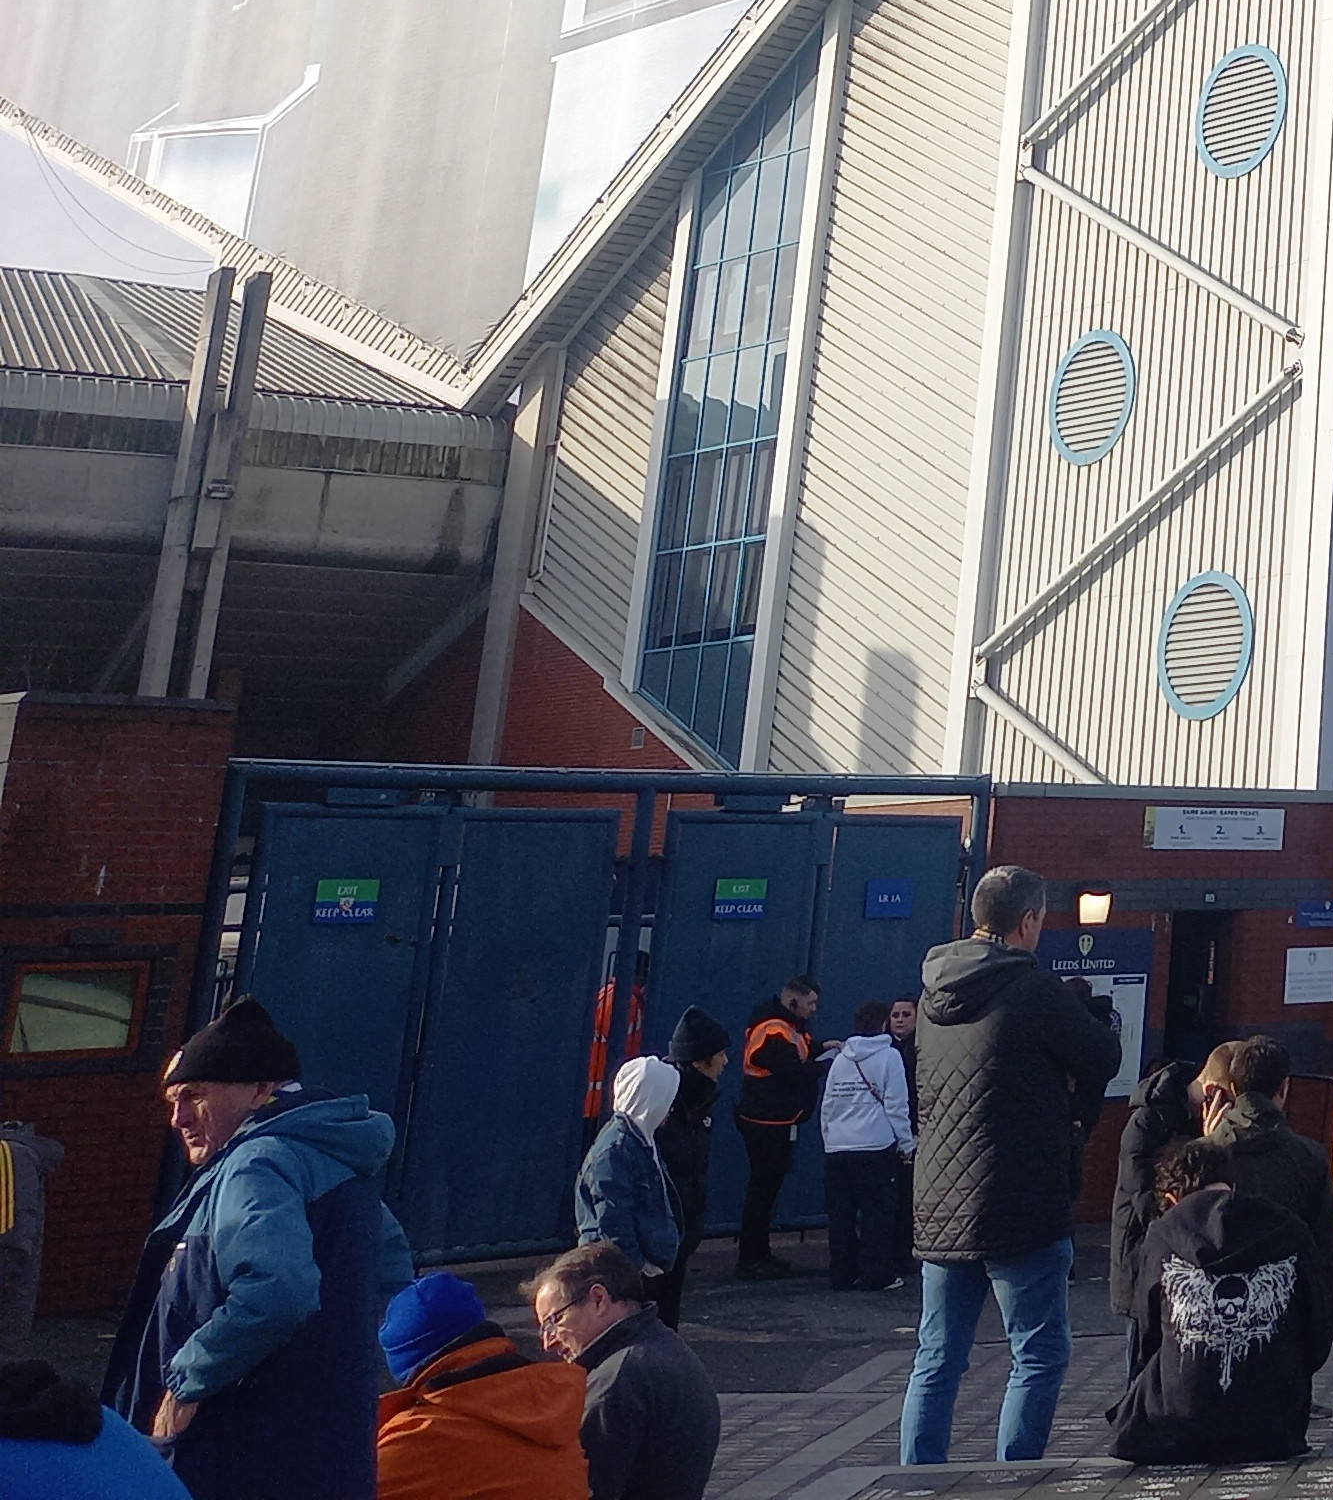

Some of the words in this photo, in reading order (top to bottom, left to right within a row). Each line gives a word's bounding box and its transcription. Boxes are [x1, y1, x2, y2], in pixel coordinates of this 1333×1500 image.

[337, 885, 359, 896] EXIT
[715, 905, 736, 914] KEEP
[737, 904, 764, 914] CLEAR
[1052, 959, 1080, 971] LEEDS
[1081, 958, 1116, 970] UNITED
